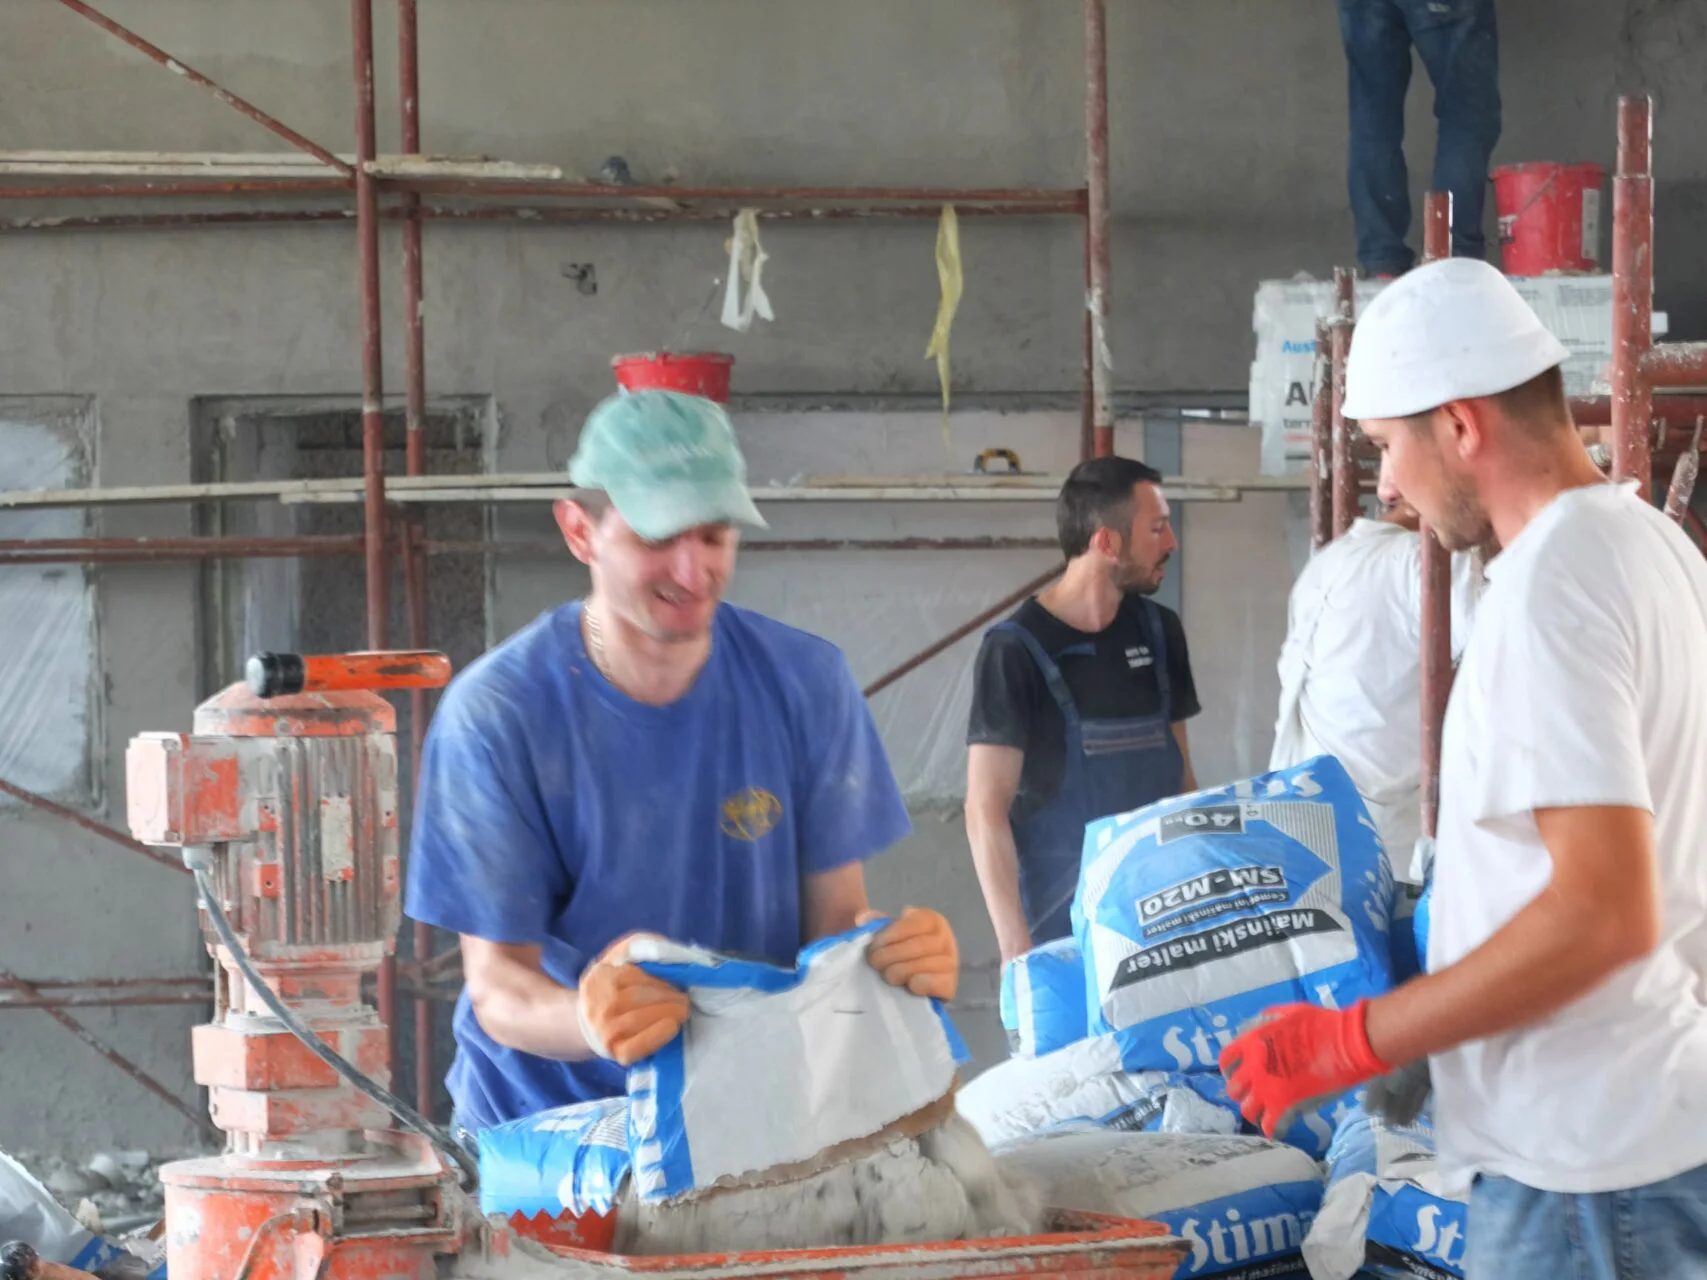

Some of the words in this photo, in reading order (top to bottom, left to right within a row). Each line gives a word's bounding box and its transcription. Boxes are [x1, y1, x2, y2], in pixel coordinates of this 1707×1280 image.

[1229, 868, 1281, 887] SM
[1143, 878, 1211, 916] M20
[1126, 938, 1208, 975] malter
[1248, 1258, 1305, 1280] mašinsk
